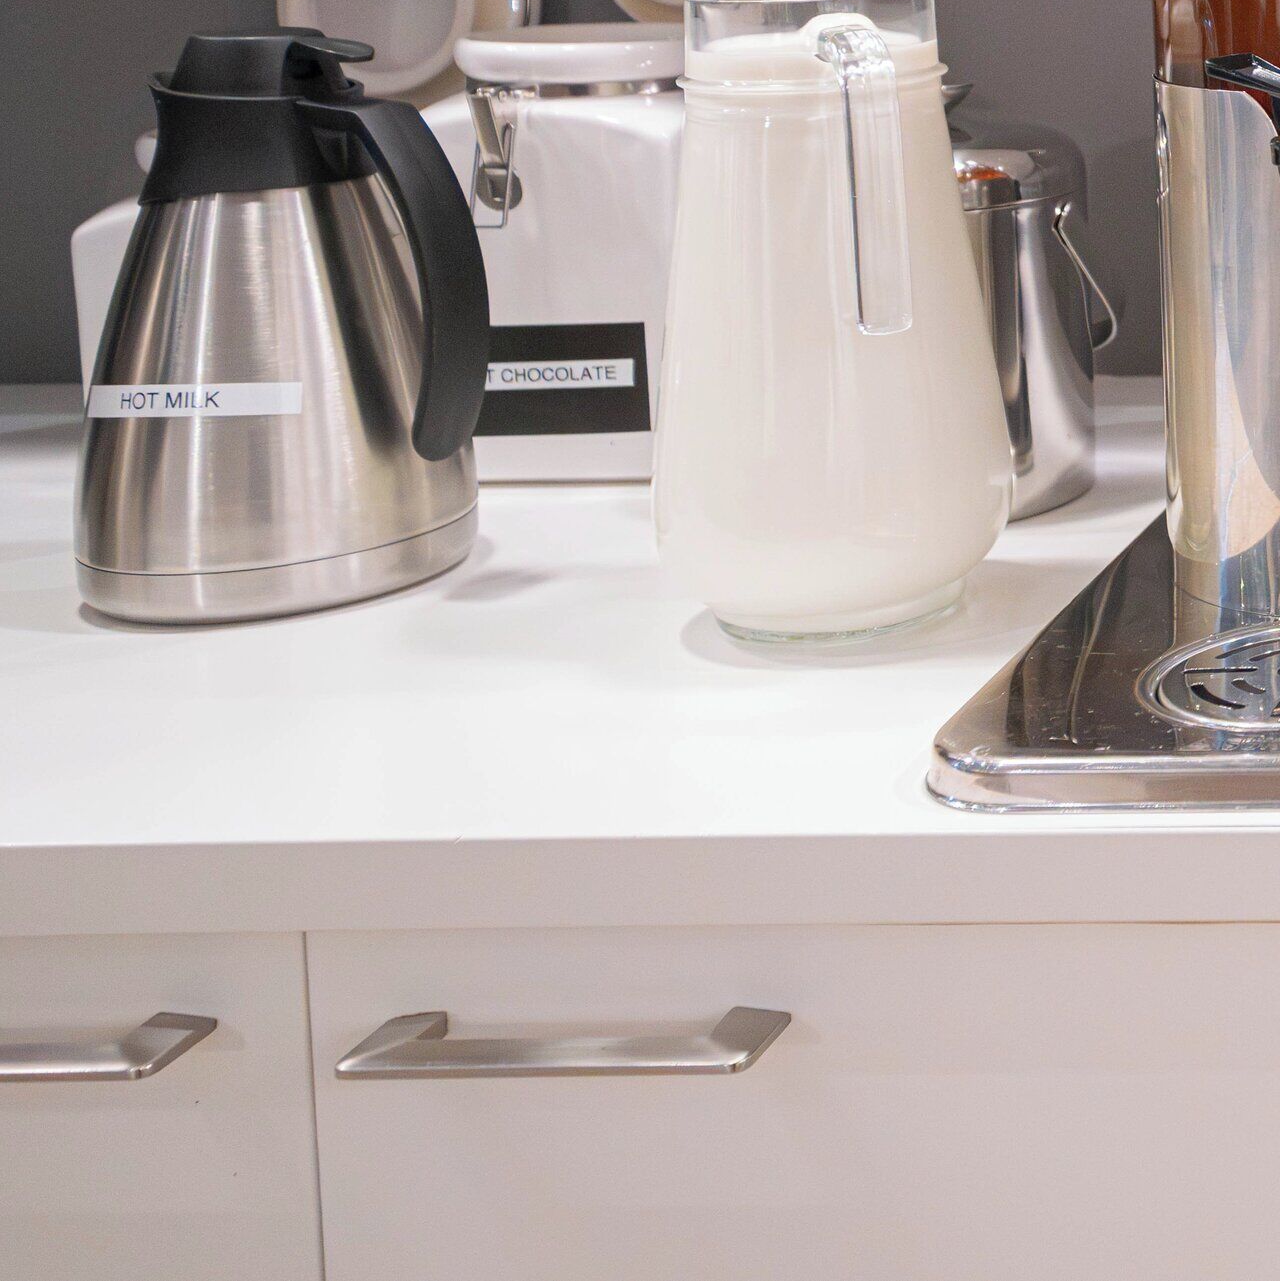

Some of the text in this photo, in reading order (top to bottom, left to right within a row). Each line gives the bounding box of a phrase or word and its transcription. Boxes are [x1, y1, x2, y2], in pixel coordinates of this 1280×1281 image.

[501, 365, 616, 383] CHOCOLATE
[120, 391, 220, 410] HOT MILK
